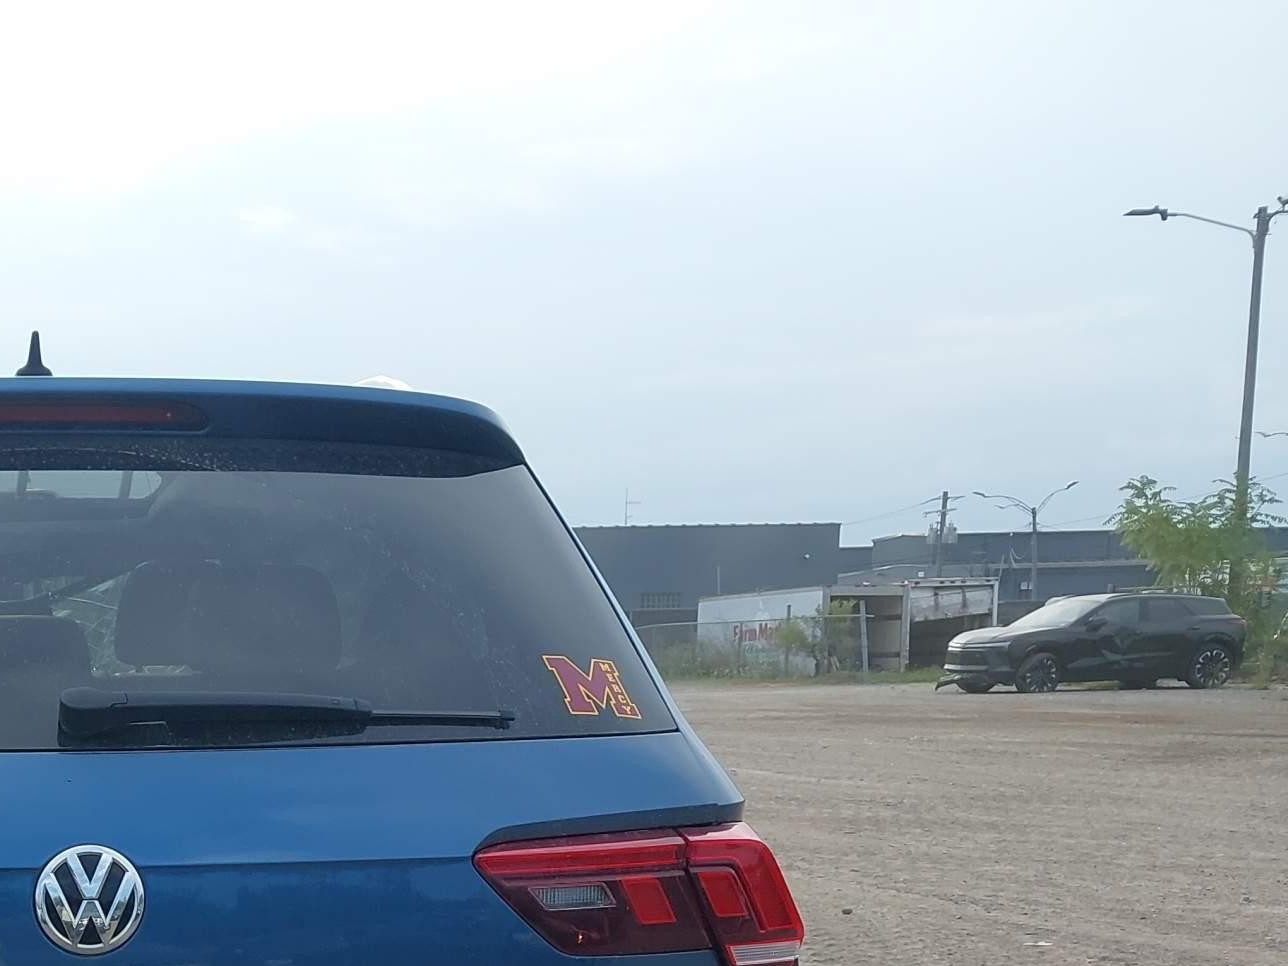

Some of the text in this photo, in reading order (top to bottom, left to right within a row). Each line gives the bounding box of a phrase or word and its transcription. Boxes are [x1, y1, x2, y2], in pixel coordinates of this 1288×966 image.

[733, 622, 758, 642] Frm
[542, 655, 642, 719] M
[39, 848, 140, 951] VW
